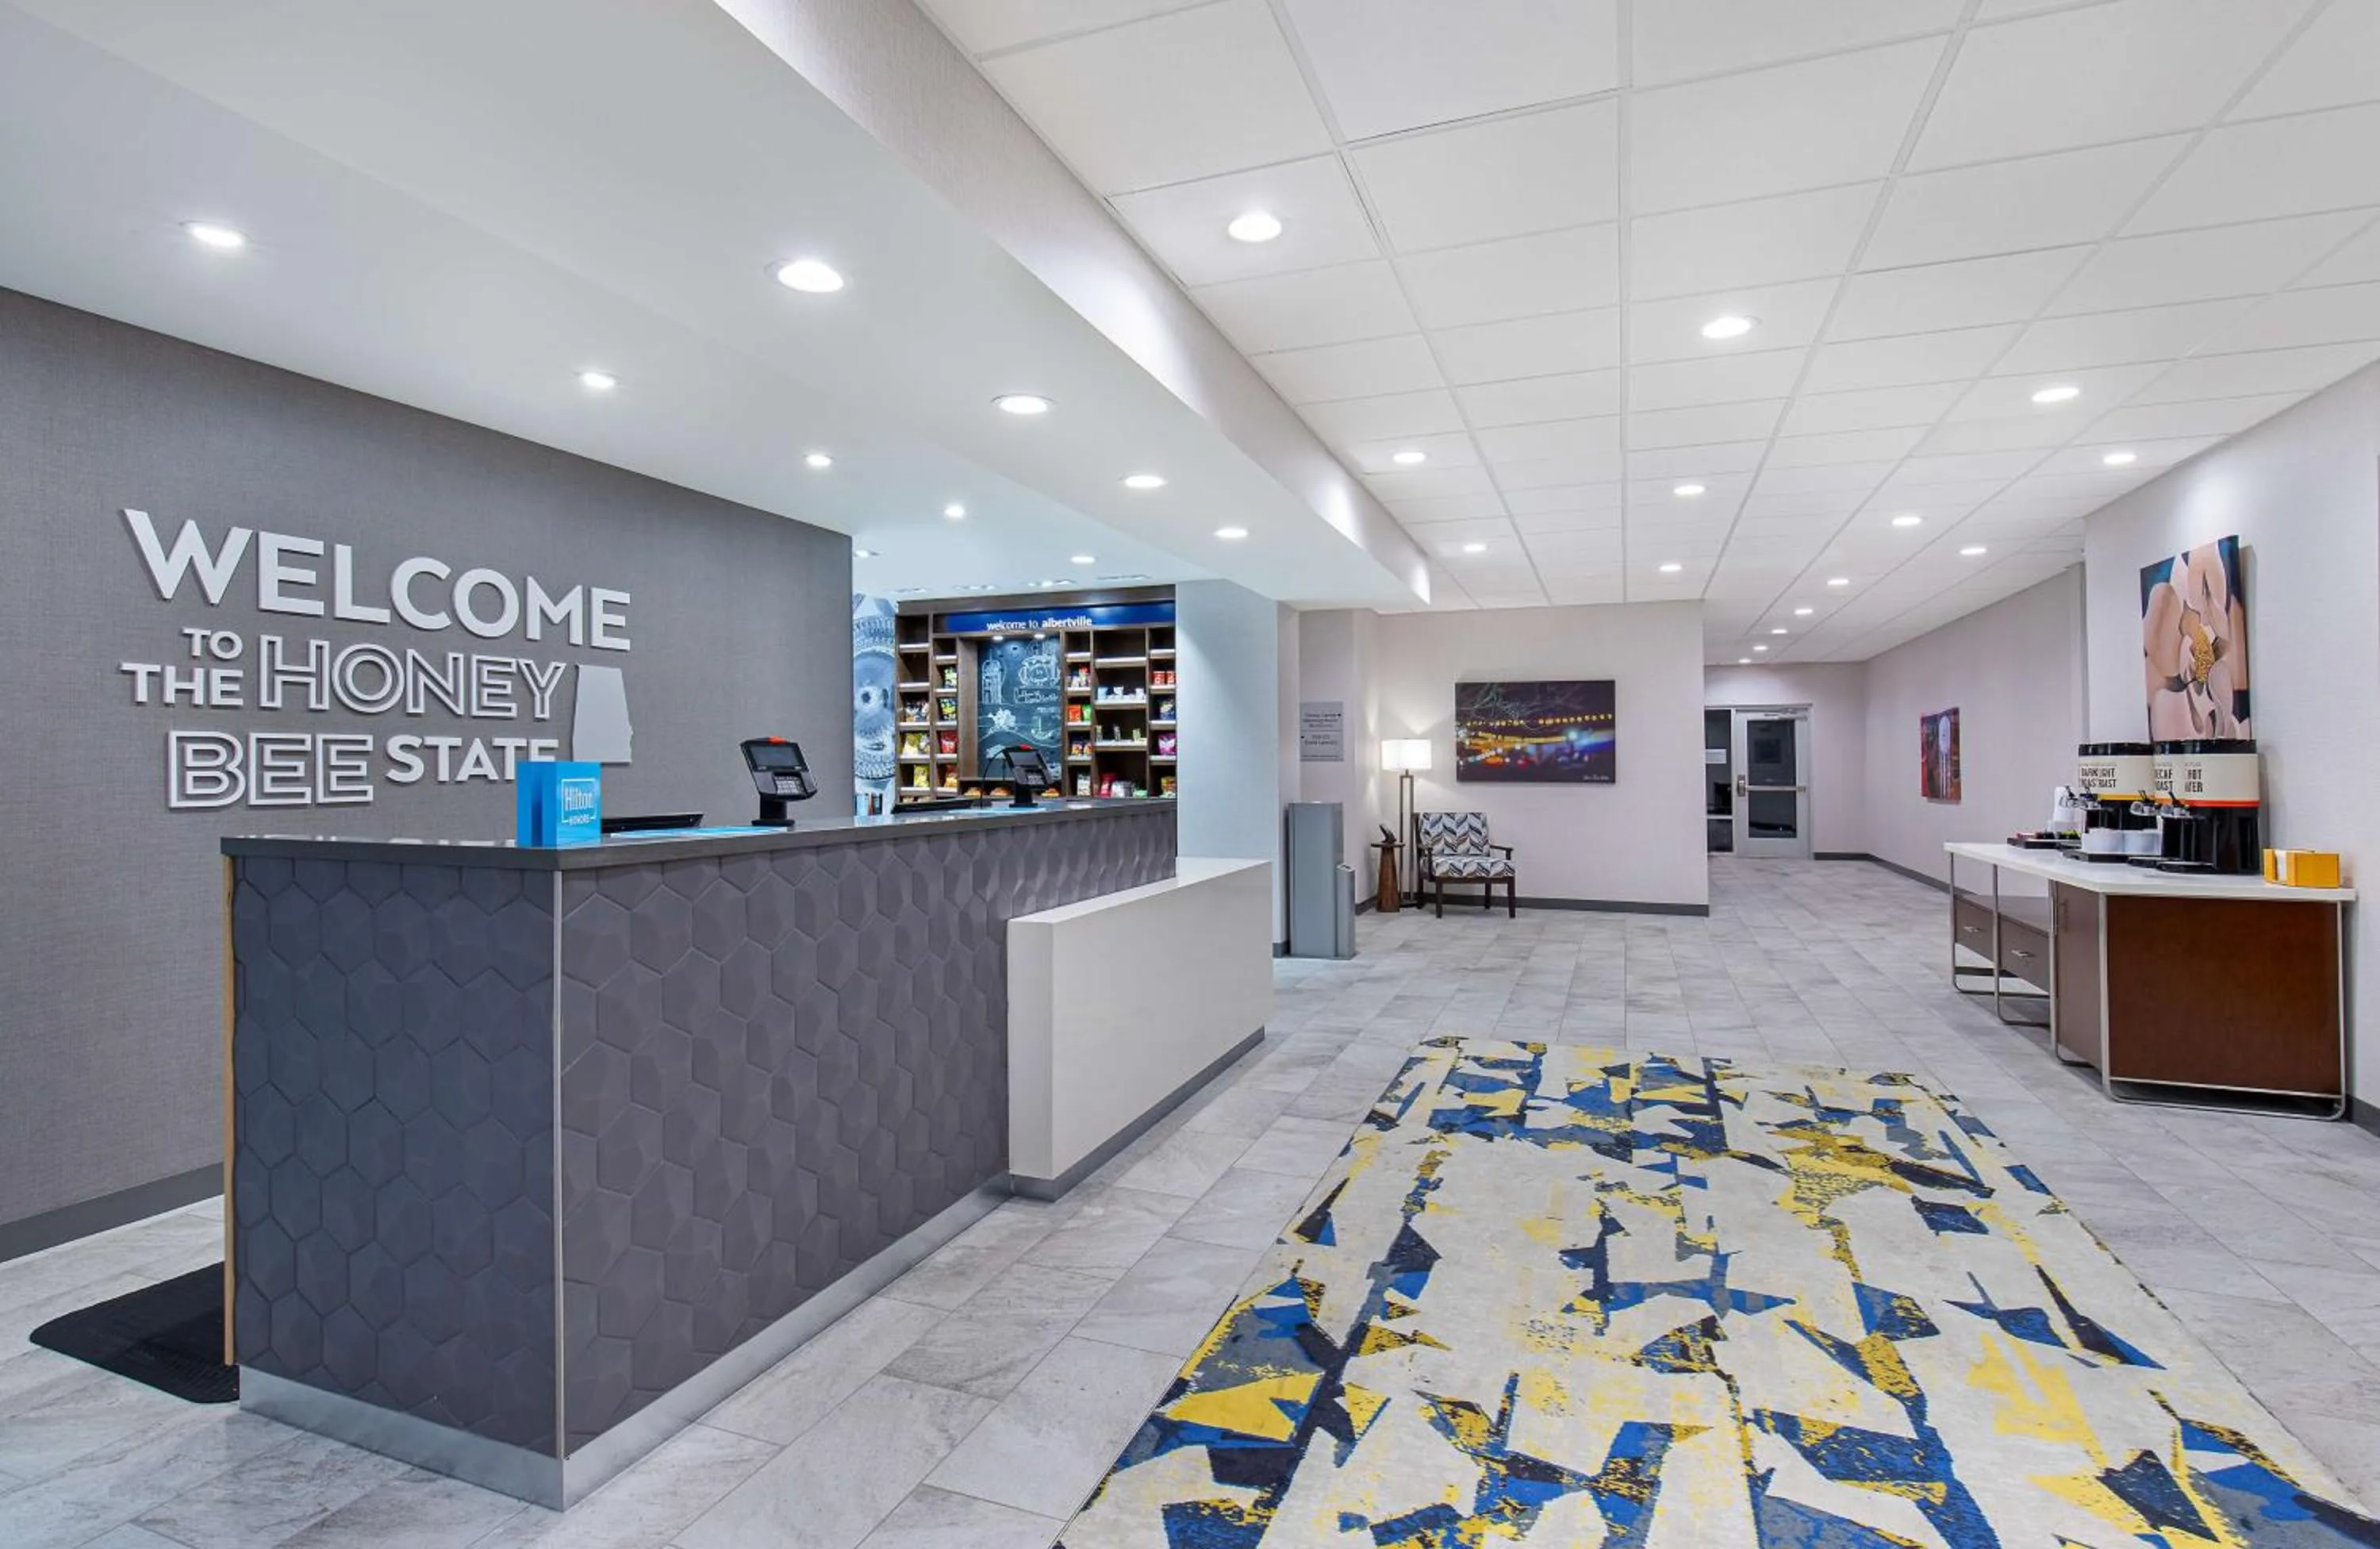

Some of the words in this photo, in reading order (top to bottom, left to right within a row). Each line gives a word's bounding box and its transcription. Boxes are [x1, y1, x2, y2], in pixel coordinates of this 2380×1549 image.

[123, 508, 631, 651] WELCOME
[182, 627, 244, 660] TO
[986, 620, 1026, 631] welcome
[1042, 615, 1092, 628] albertville
[119, 661, 244, 708] THE
[258, 633, 567, 721] HONEY
[167, 728, 374, 809] BEE
[564, 786, 594, 812] Hilton
